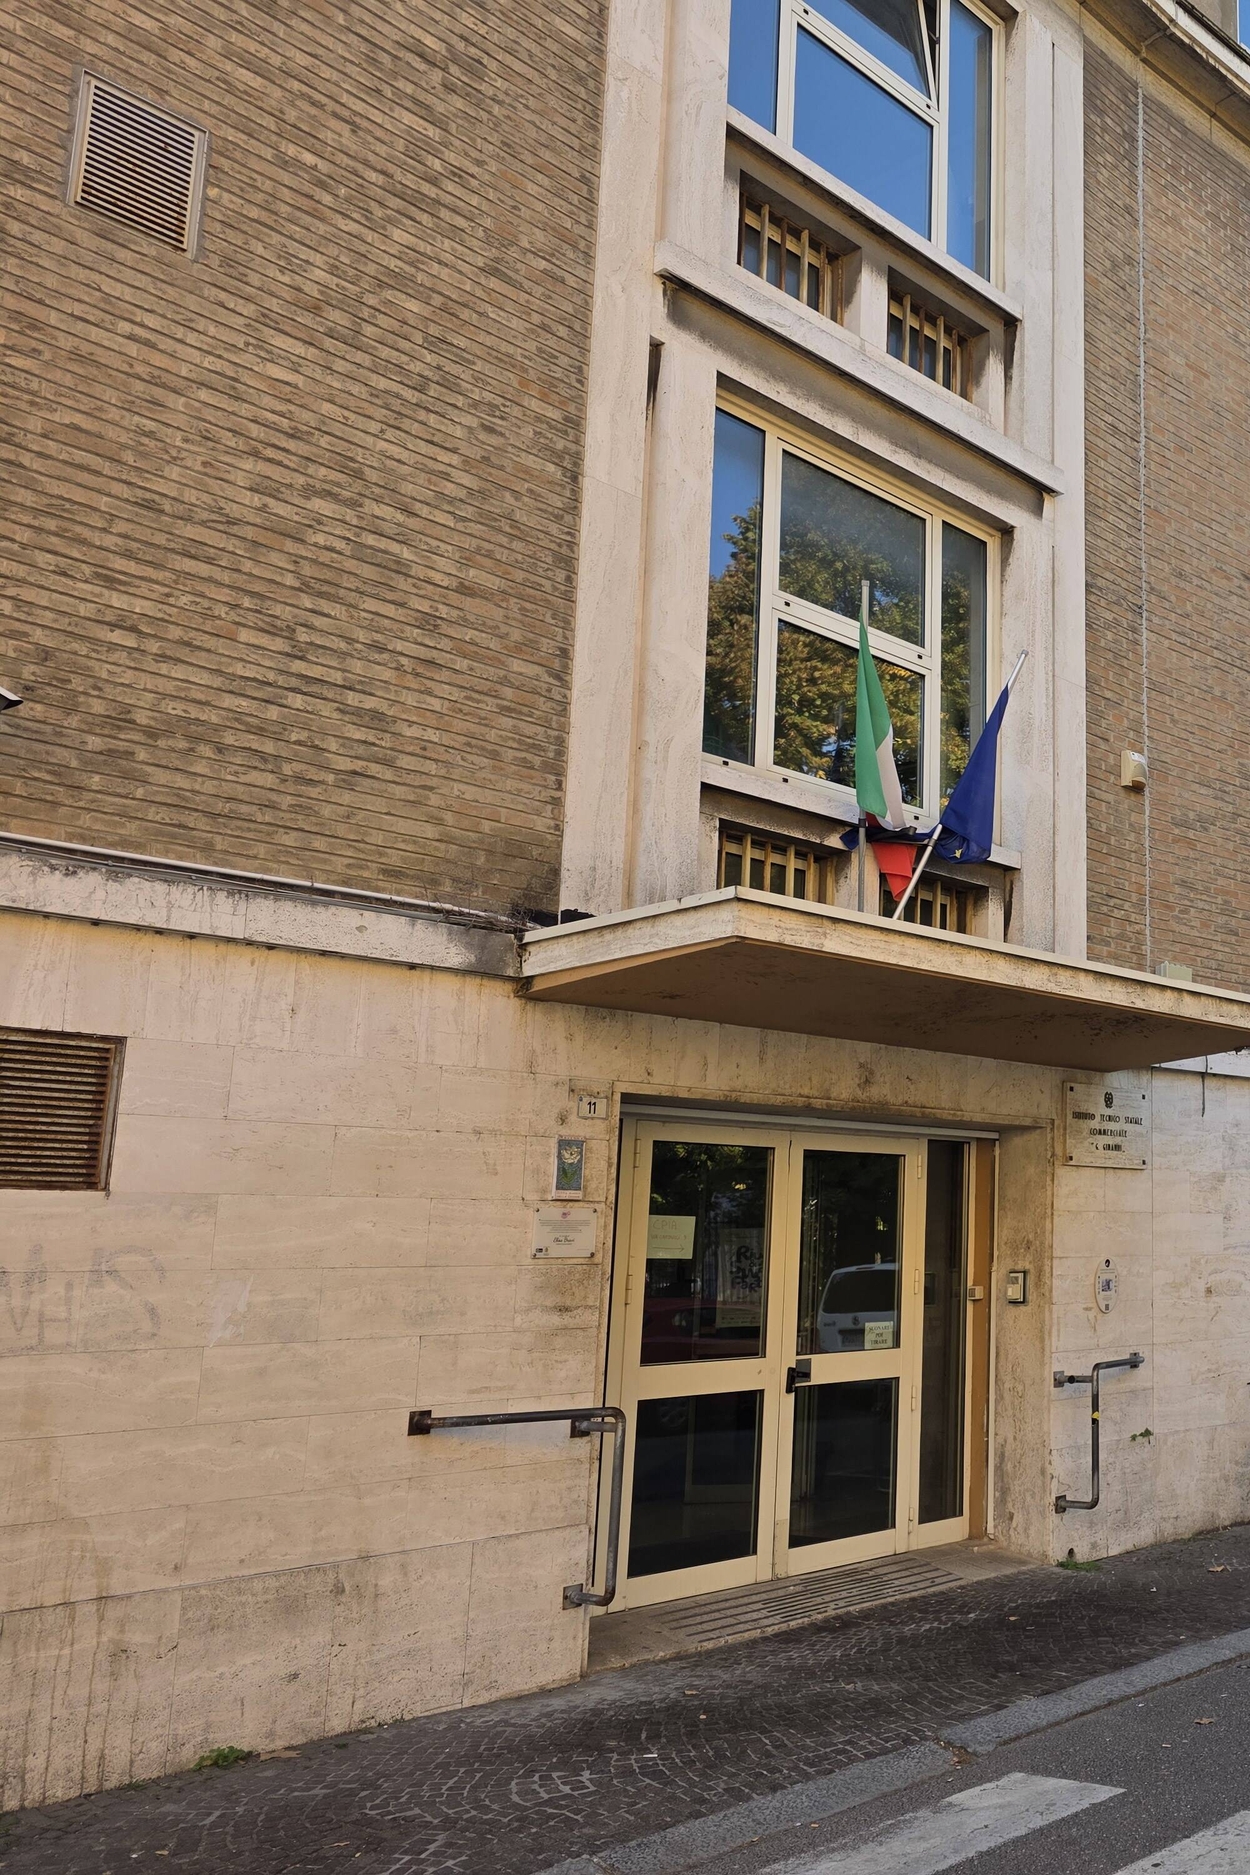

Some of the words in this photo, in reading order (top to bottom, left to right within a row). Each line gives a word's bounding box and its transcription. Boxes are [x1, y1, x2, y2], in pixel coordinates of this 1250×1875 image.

[587, 1101, 597, 1114] 11
[1072, 1111, 1096, 1121] ISTITUTO
[1100, 1113, 1121, 1123] TECNICO
[1124, 1116, 1143, 1126] STATALE
[1090, 1128, 1128, 1138] COMMERCIALE
